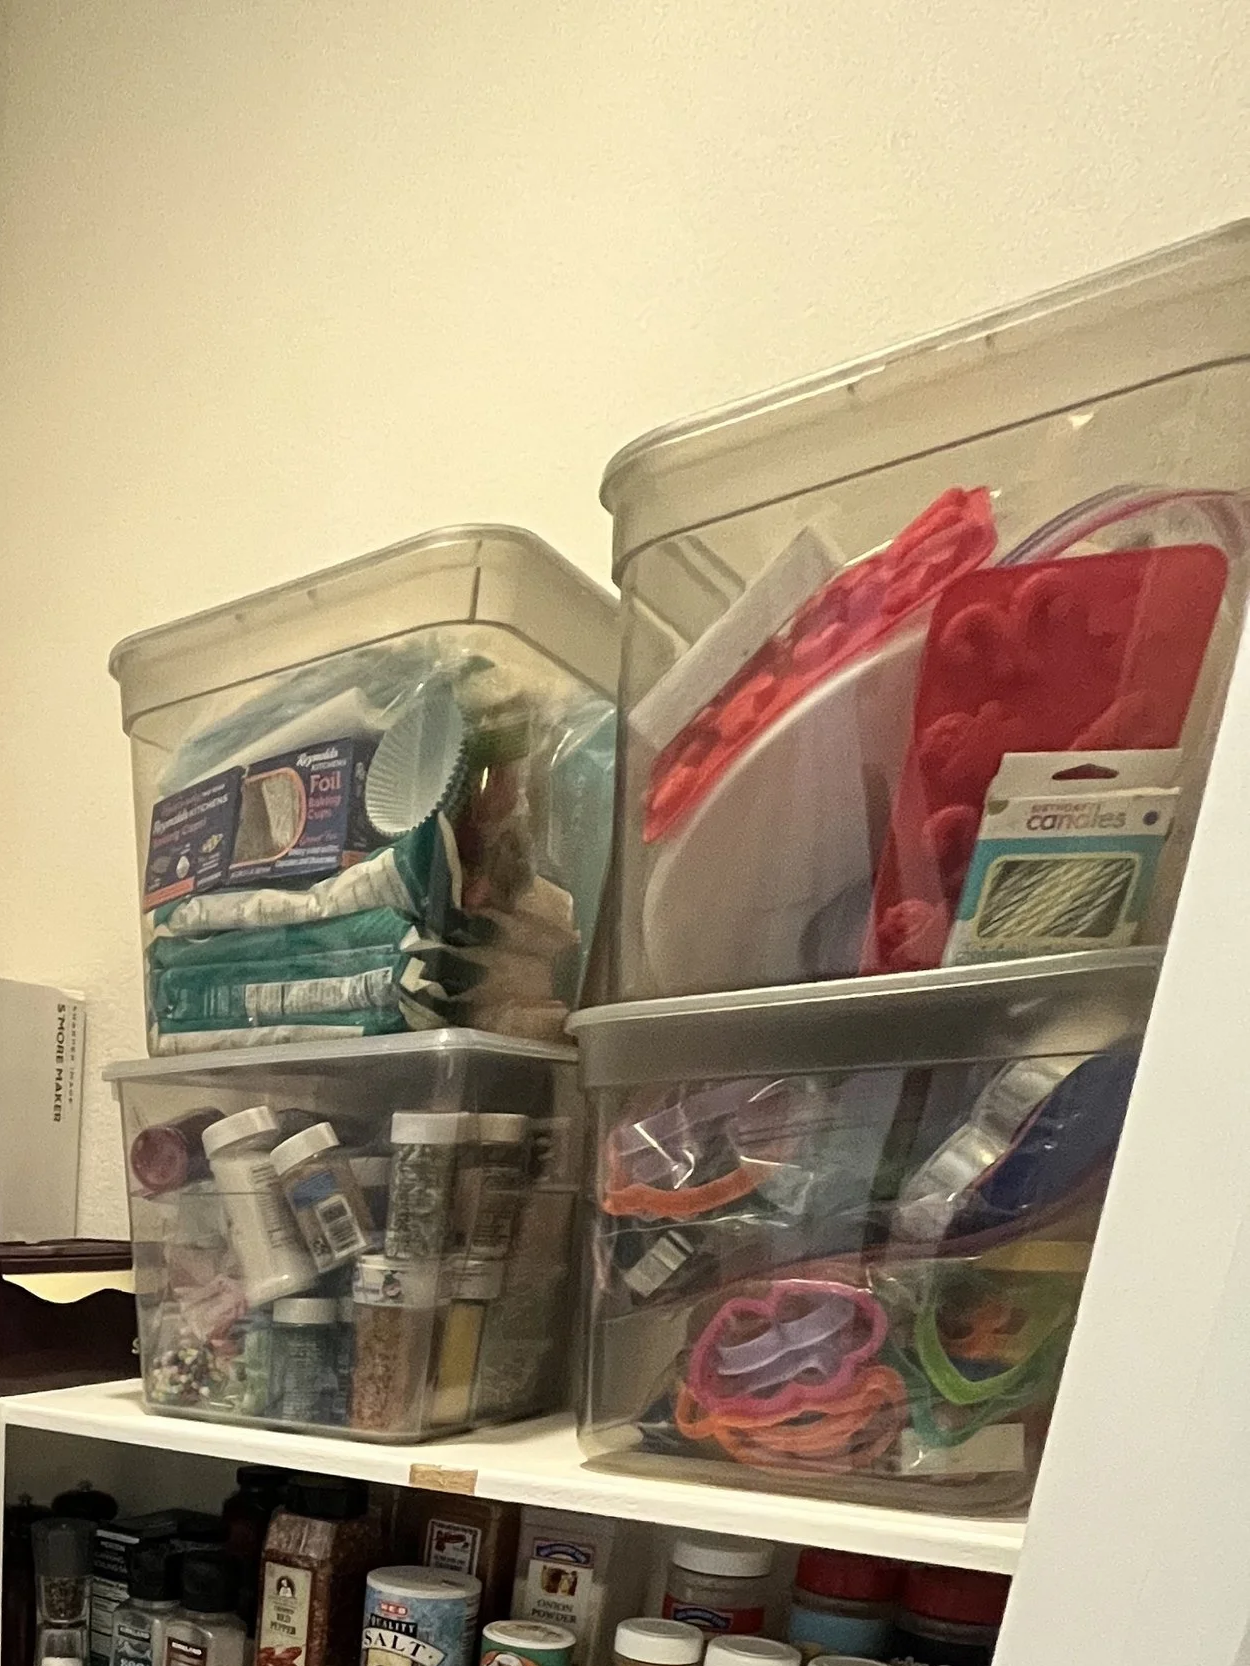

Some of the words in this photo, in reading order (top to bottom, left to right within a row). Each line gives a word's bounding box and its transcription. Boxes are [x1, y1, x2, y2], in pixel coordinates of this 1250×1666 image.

[310, 772, 342, 793] Foil
[1026, 804, 1126, 831] candles
[53, 1068, 64, 1123] MAKER
[370, 1616, 416, 1634] QUALITY
[531, 1609, 577, 1624] POWDER
[270, 1621, 296, 1636] PEPPER
[363, 1629, 426, 1657] SALT
